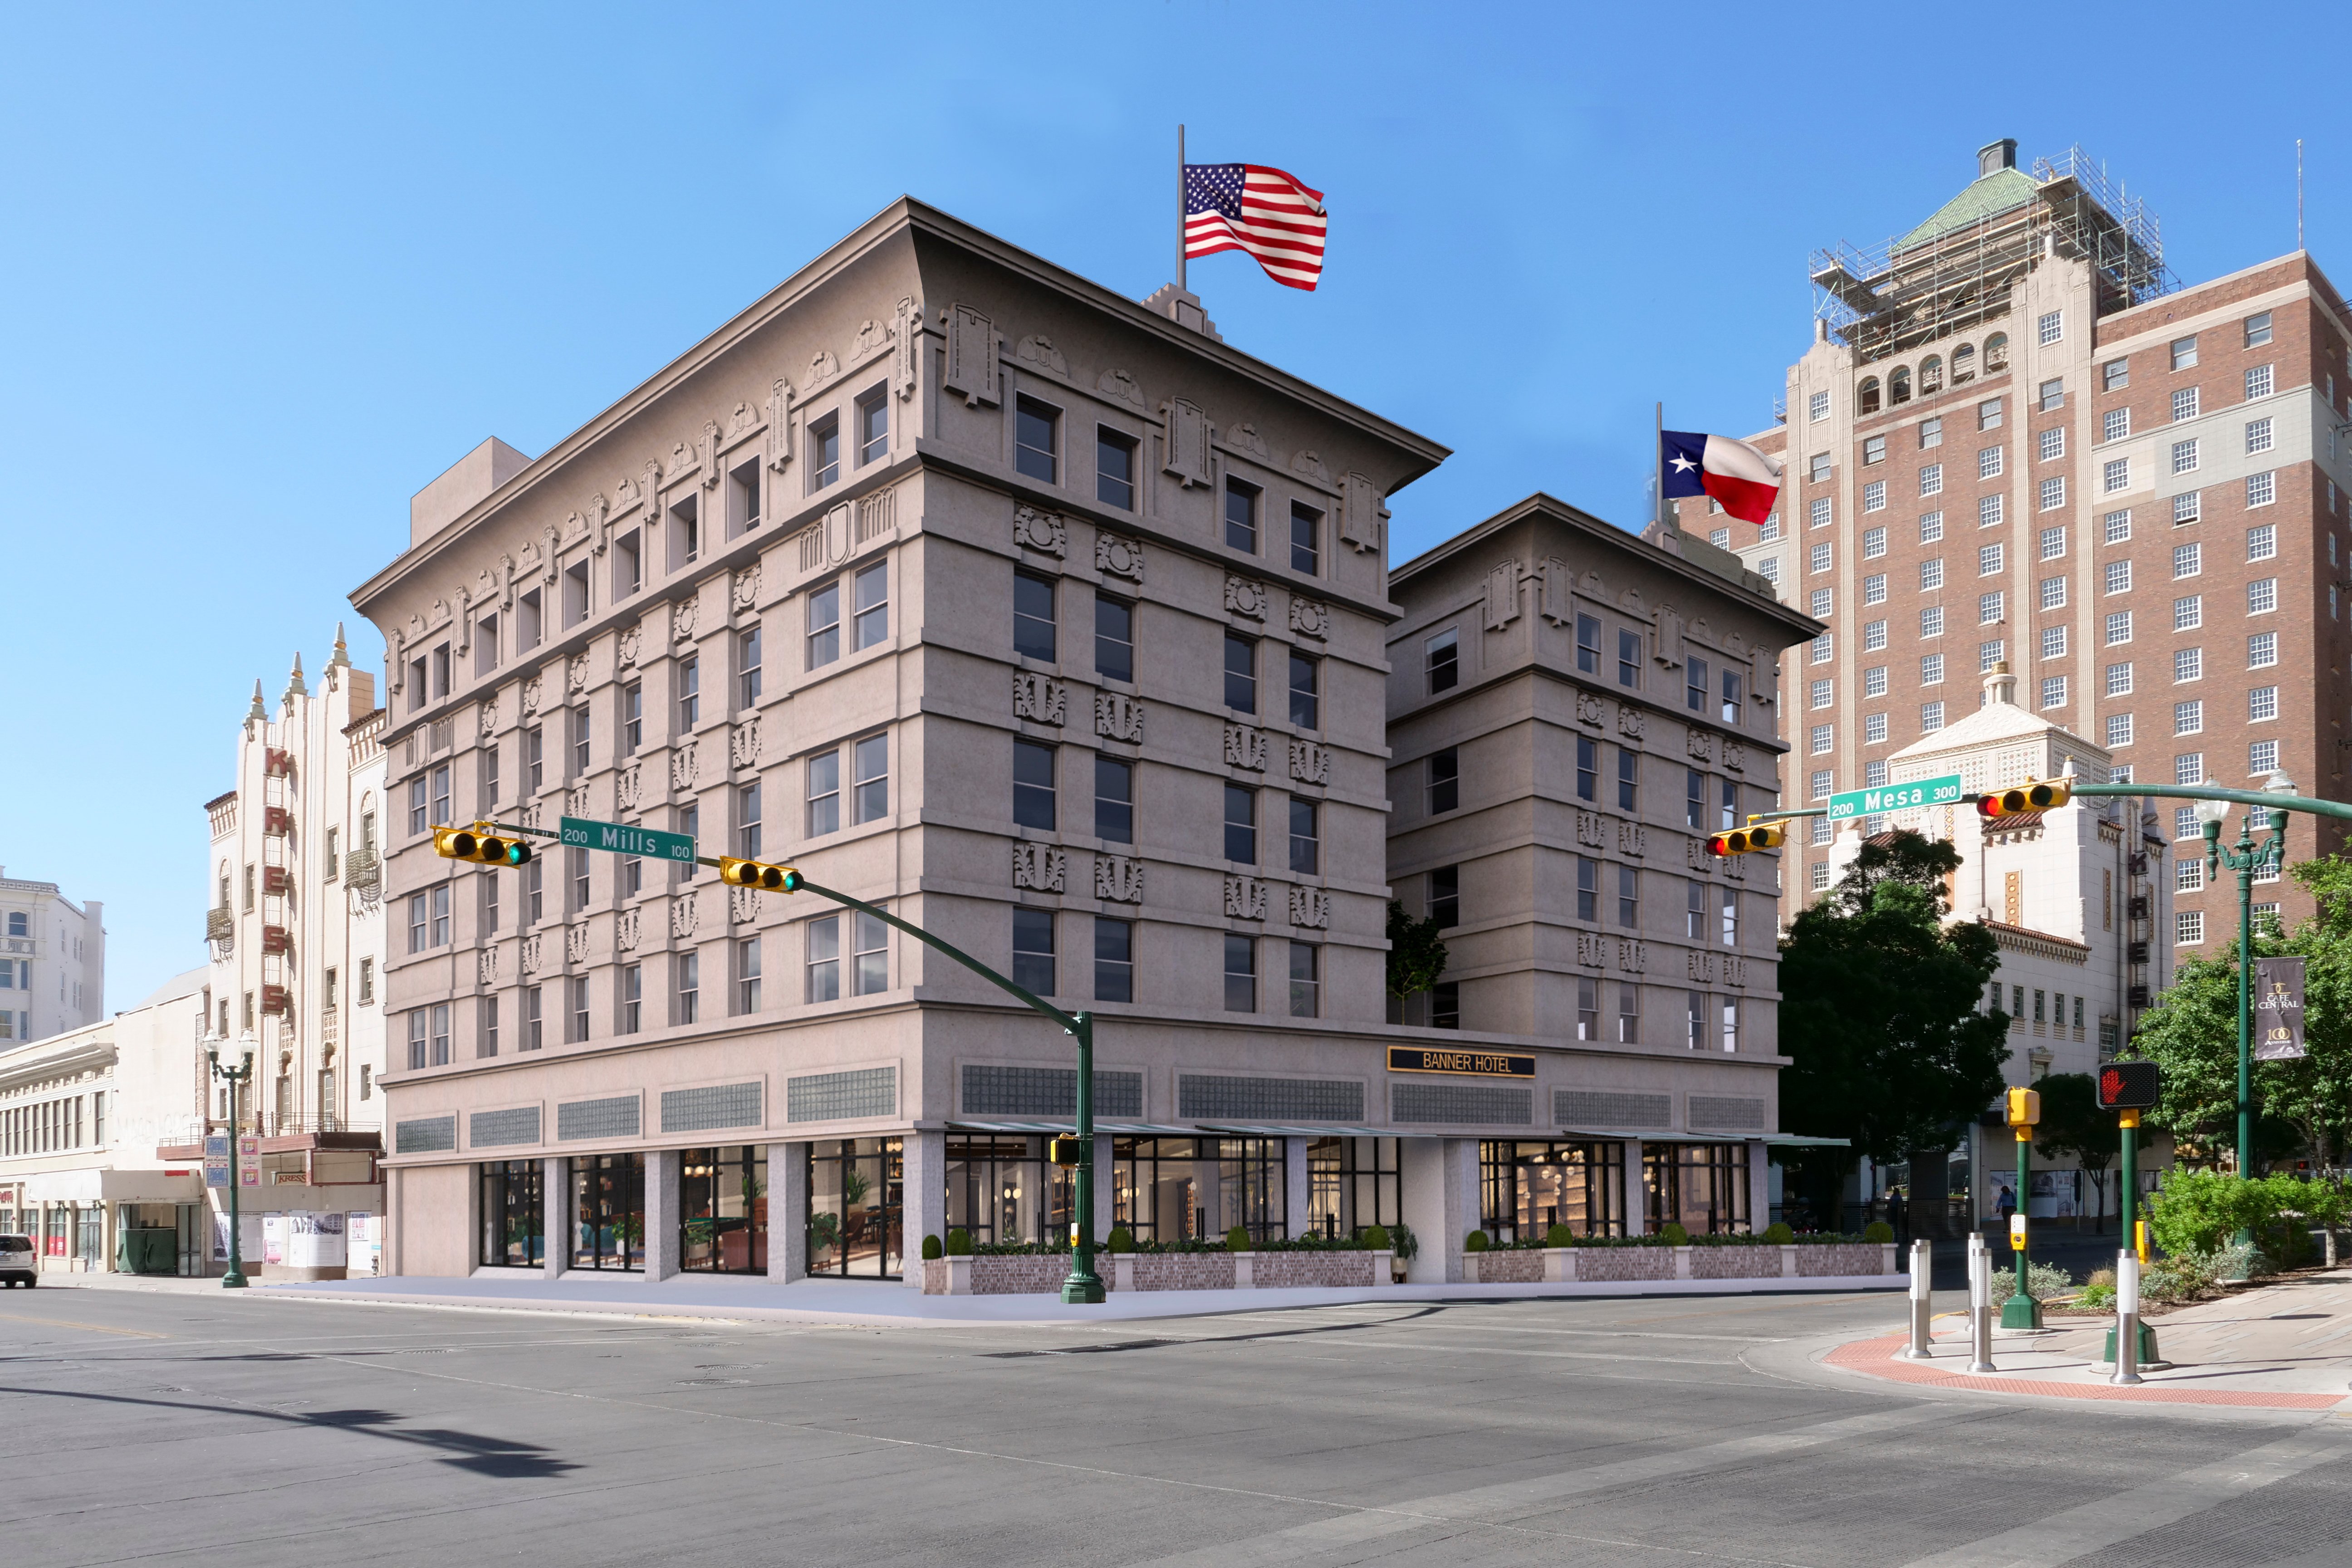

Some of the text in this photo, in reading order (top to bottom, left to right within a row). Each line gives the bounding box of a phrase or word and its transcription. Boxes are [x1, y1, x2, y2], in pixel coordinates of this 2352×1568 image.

[1832, 785, 1956, 816] 200 Mesa 300
[564, 827, 689, 858] 200 Mills 100
[263, 748, 287, 1011] KRESS
[2131, 853, 2148, 1051] KRES
[2259, 1001, 2299, 1010] CENTRAL
[2266, 1028, 2290, 1040] 100
[1423, 1053, 1512, 1073] BANNER HOTEL
[279, 1174, 306, 1183] KRESS
